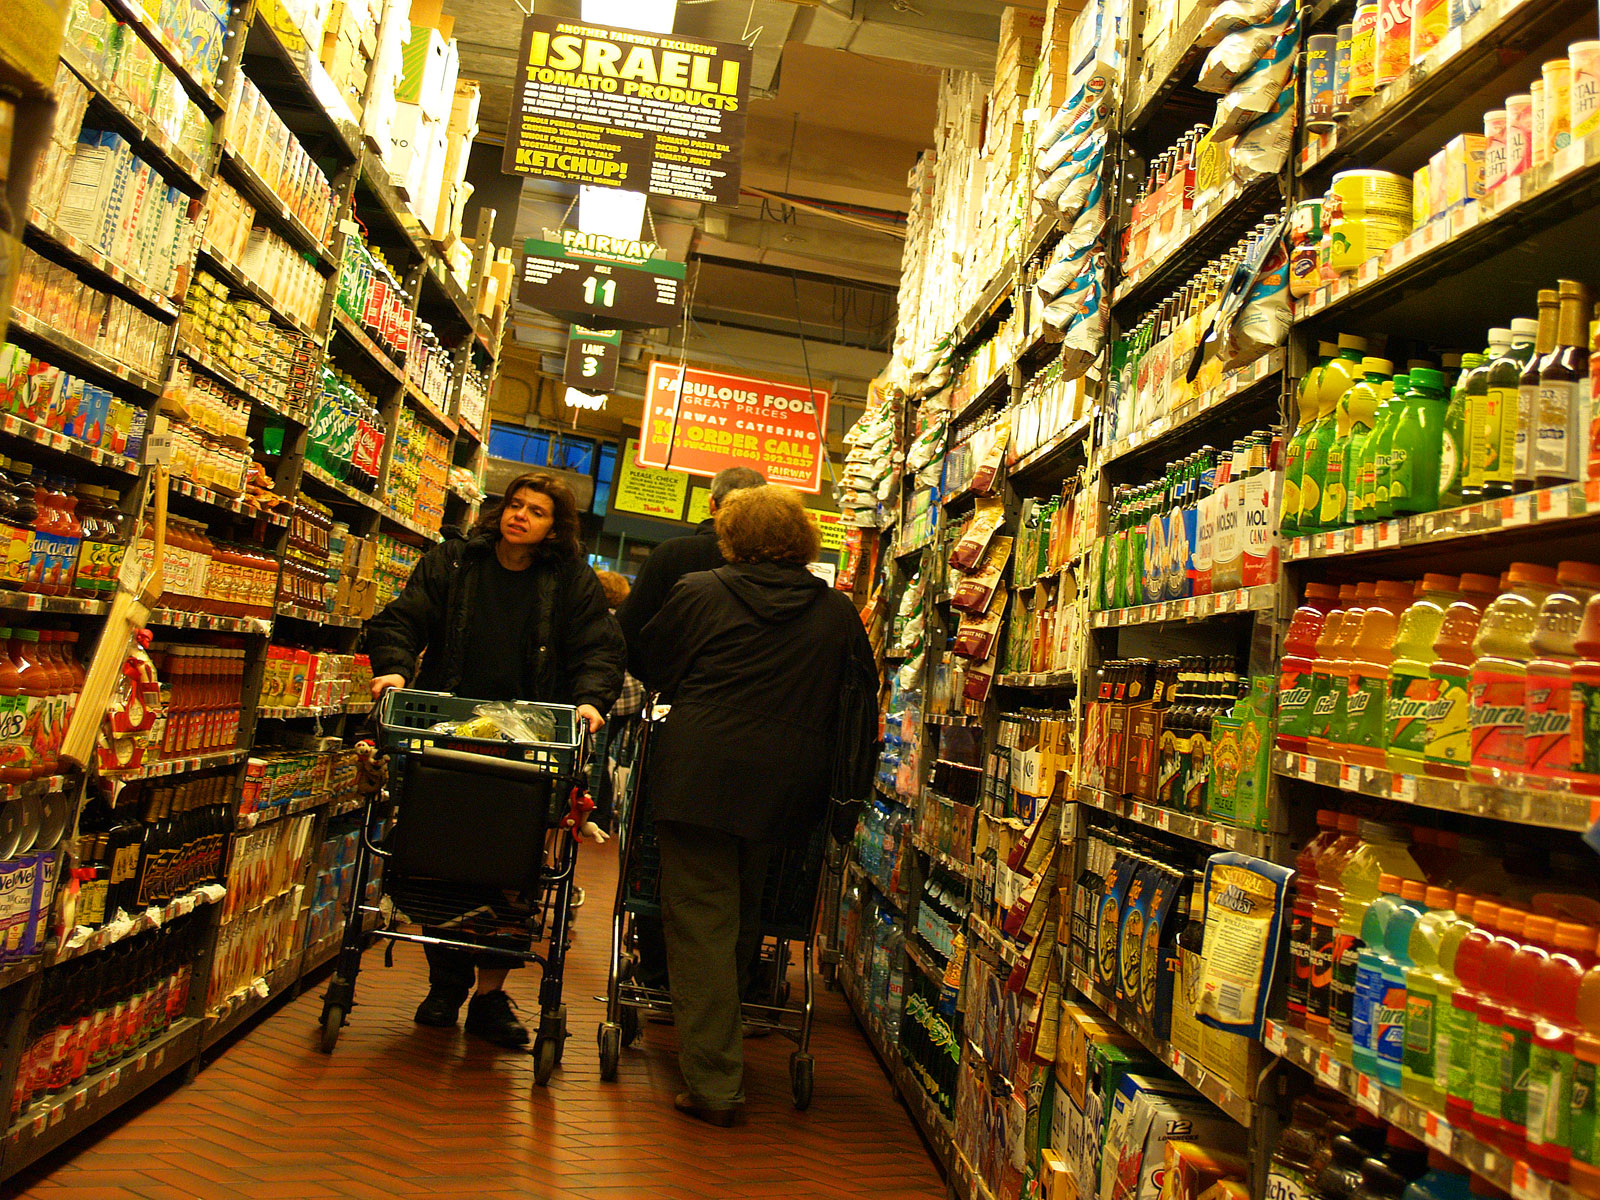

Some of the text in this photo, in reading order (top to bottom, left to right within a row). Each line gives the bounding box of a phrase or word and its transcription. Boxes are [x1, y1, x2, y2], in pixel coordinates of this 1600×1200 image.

[556, 23, 717, 56] ANOTHER FAIRWAY EXCLUSIVE
[529, 31, 740, 96] ISRAELI
[526, 66, 738, 111] TOMATO PRODUCTS
[559, 128, 600, 141] TOMATOES
[606, 126, 643, 139] TOMATOES
[520, 140, 562, 152] VEGETABLE
[564, 145, 585, 156] JUICE
[521, 132, 622, 152] WHOLE PEELED TOMATOES
[655, 143, 721, 159] DICED TOMATOES
[656, 134, 690, 146] TOMATO
[692, 139, 714, 150] PASTE
[516, 148, 628, 179] KETCHUP!
[655, 151, 711, 166] TOMATO JUICE
[100, 147, 128, 248] parmalat
[122, 169, 148, 266] parmalat
[563, 230, 656, 258] FAIRWAY
[527, 257, 579, 270] KOSHER FOODS
[594, 265, 612, 274] AISLE
[583, 277, 616, 308] 11
[582, 344, 605, 356] LANE
[582, 357, 597, 377] 3
[658, 377, 816, 415] FABULOUS FOOD
[684, 396, 788, 420] GREAT PRICES
[736, 420, 816, 440] CATERING
[653, 420, 814, 459] TO ORDER CALL
[763, 451, 813, 468] 392.2837
[630, 471, 678, 484] PLEASE CHECK
[767, 465, 812, 480] FAIRWAY
[1216, 511, 1238, 531] MOLSON
[1246, 510, 1267, 526] MOL
[1250, 530, 1267, 544] CANA
[448, 742, 508, 758] FAIRWAY
[1222, 870, 1262, 890] NATURAL
[1226, 885, 1246, 899] NUT
[1215, 893, 1254, 914] HARVEST
[1166, 1120, 1193, 1135] 12
